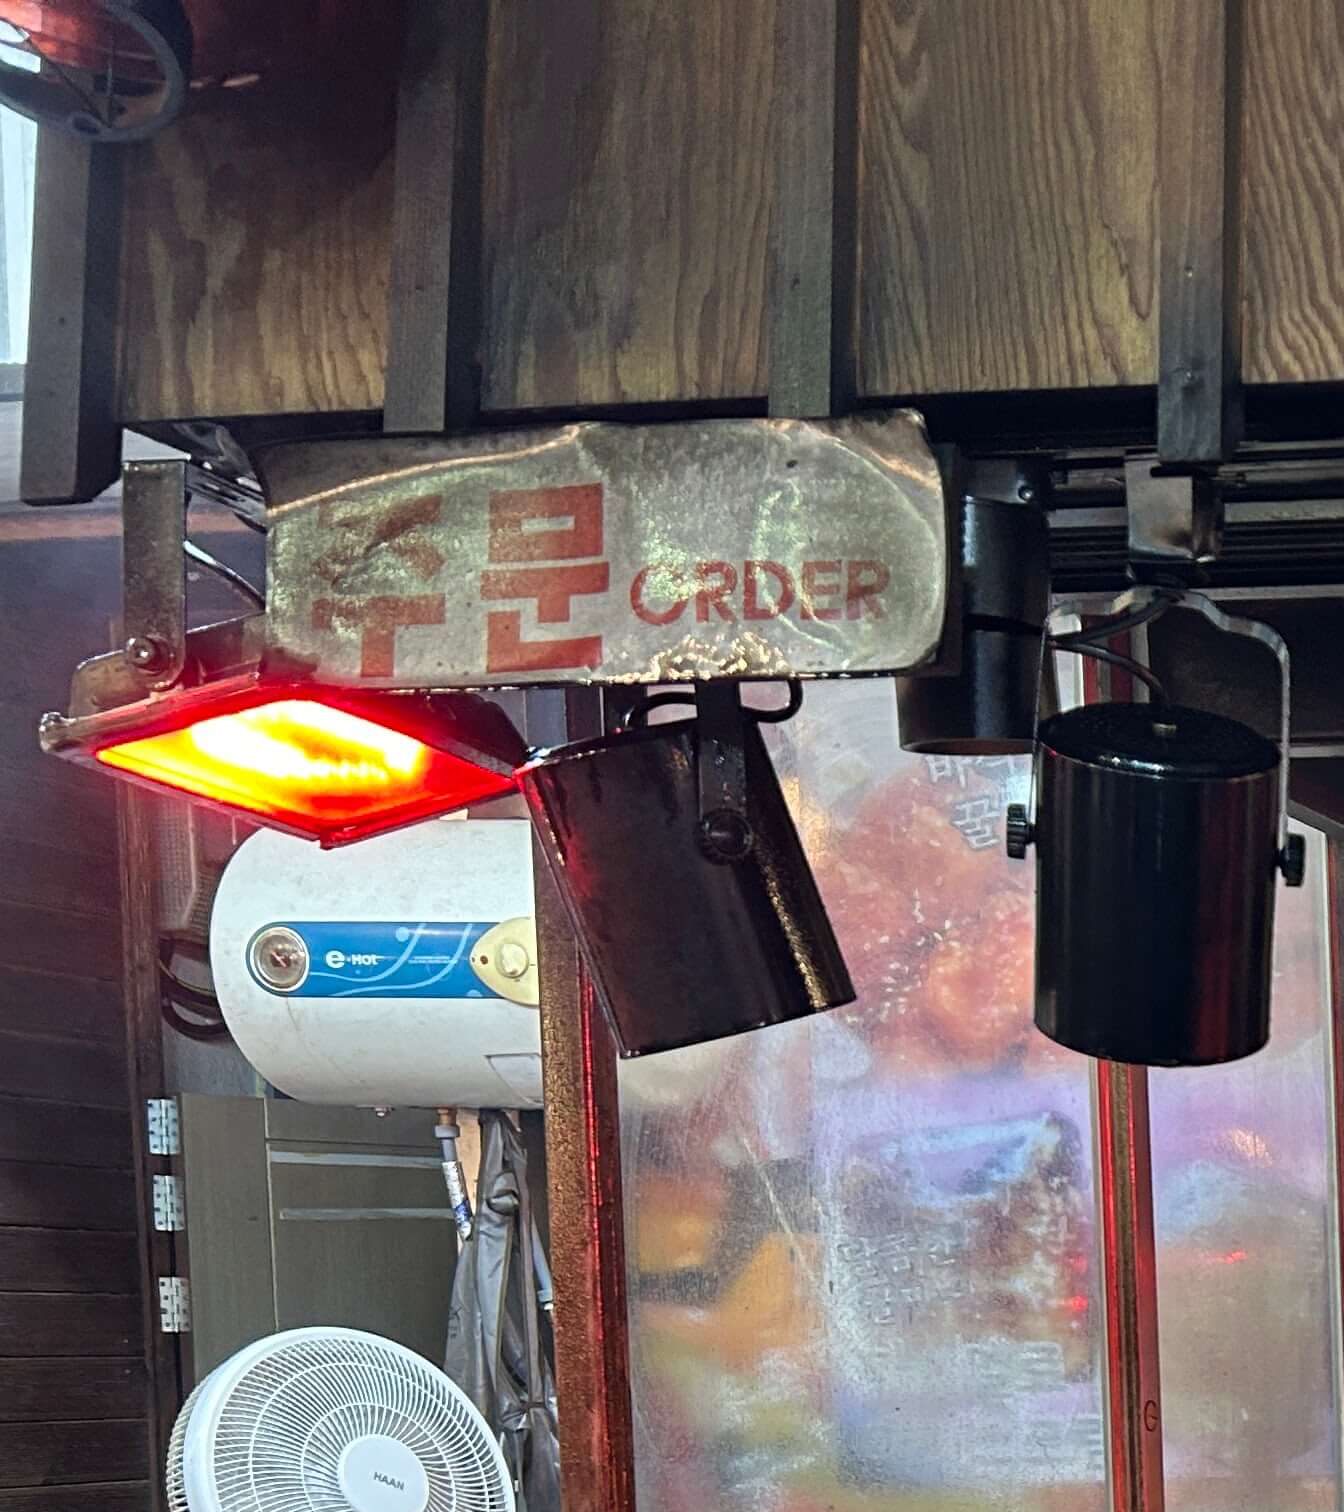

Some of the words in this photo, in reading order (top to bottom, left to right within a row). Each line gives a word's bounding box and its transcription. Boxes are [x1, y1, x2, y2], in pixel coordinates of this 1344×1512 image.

[312, 483, 609, 678] 주문
[630, 559, 891, 626] ORDER
[373, 1471, 405, 1491] HAAN
